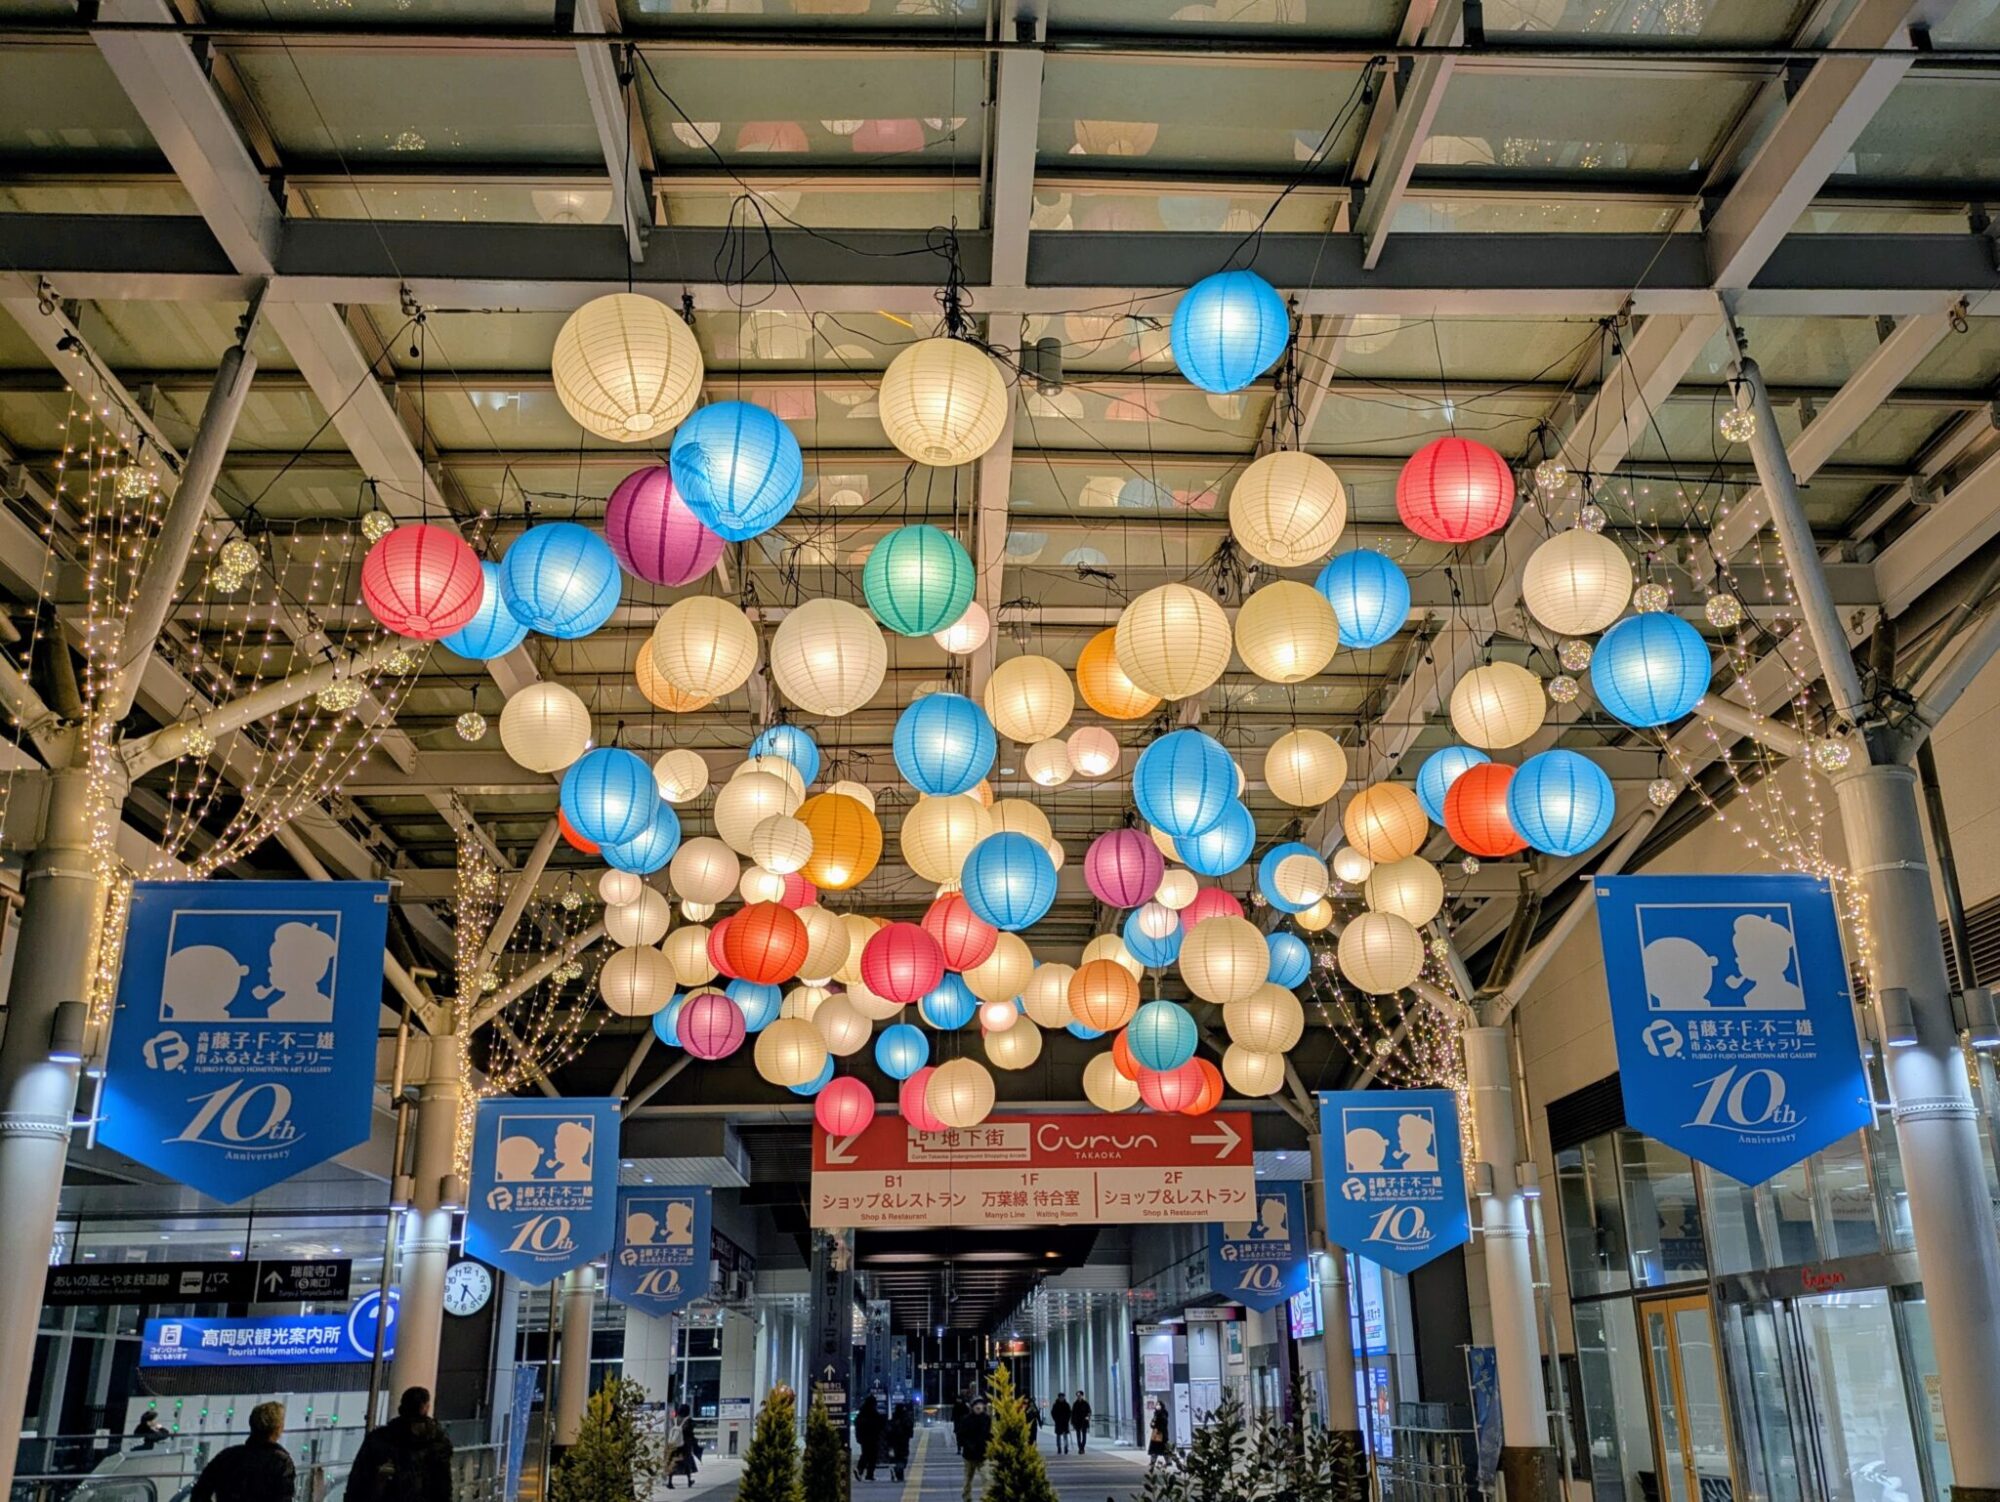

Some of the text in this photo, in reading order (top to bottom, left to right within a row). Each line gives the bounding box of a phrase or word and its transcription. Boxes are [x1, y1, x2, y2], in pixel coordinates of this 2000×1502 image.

[1703, 1038, 1816, 1051] ふるさとギャラリー
[209, 1051, 334, 1065] ふるさとギャラリー
[1692, 1064, 1797, 1125] 10th
[177, 1078, 296, 1142] 10th
[941, 1128, 1004, 1147] 地下街
[1738, 1134, 1796, 1144] Anniversary
[225, 1149, 290, 1161] Anniversary
[1075, 1152, 1122, 1160] TAKAOKA
[884, 1175, 903, 1188] B1
[1021, 1173, 1039, 1186] 1F
[1164, 1171, 1183, 1184] 2F
[822, 1192, 966, 1210] ショップ&レストラン
[981, 1190, 1080, 1208] 万葉線 待合室
[1104, 1189, 1247, 1206] ショップ&レストラン
[861, 1213, 880, 1221] Shop
[888, 1212, 927, 1220] Restaurant
[985, 1211, 1009, 1219] Manyo
[1036, 1211, 1059, 1219] Waiting
[1142, 1209, 1162, 1218] Shop
[1170, 1209, 1208, 1217] Restaurant
[1369, 1204, 1430, 1241] 10th
[511, 1213, 574, 1251] 10th
[54, 1273, 170, 1288] あいの風とやま鉄道線
[205, 1272, 230, 1284] バス
[202, 1326, 341, 1347] 高岡駅観光案内所
[227, 1346, 338, 1357] Tourist Information Center
